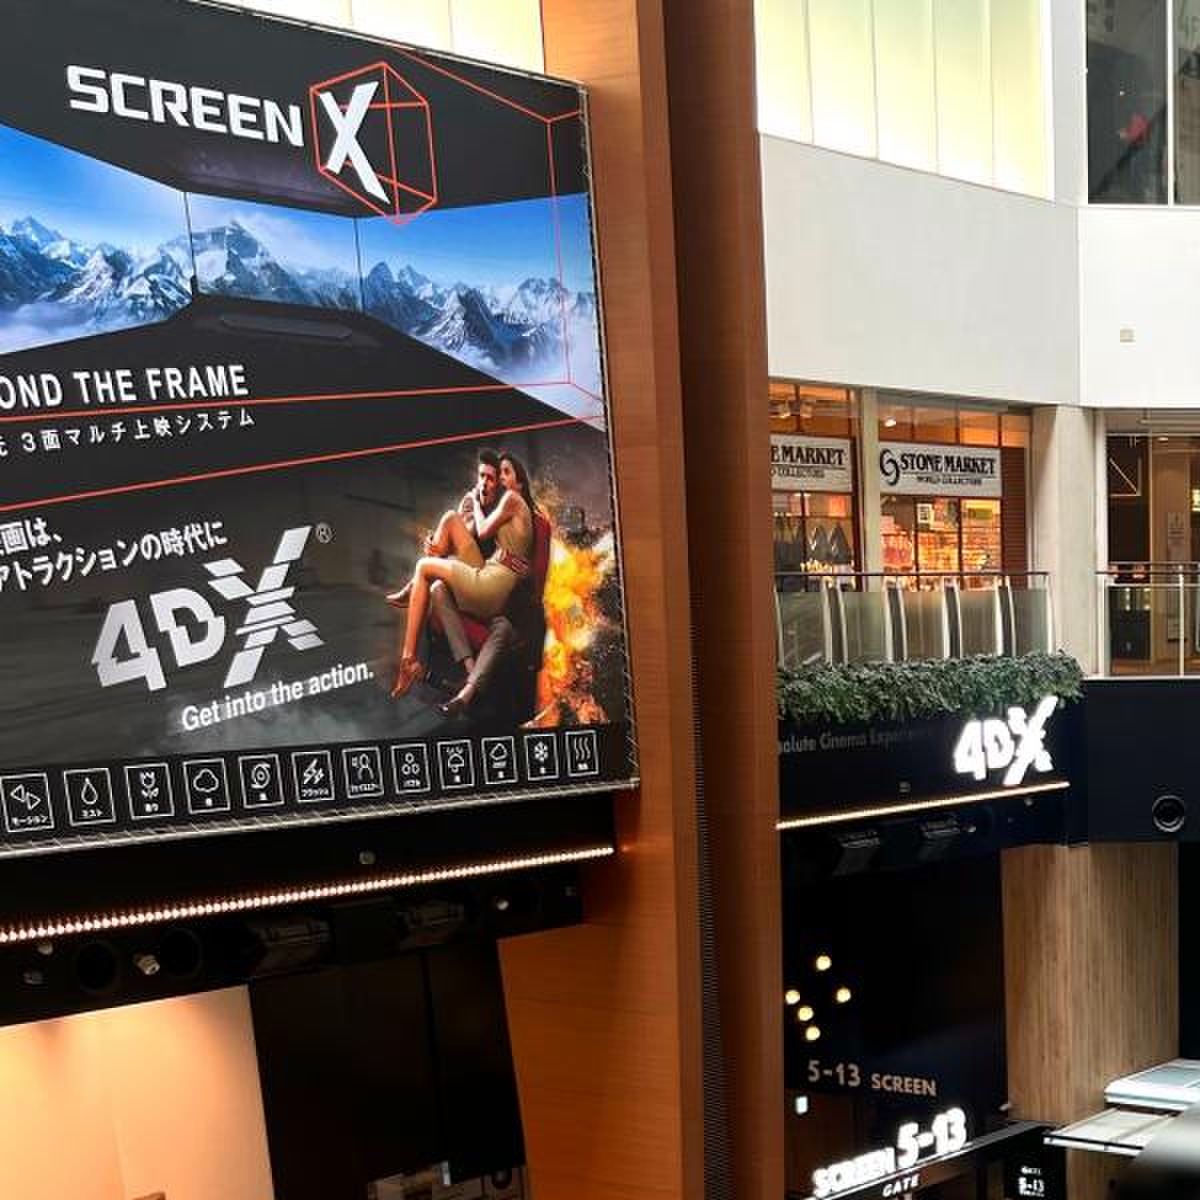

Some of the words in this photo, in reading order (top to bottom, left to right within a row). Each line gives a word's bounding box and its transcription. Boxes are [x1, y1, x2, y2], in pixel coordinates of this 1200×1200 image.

[66, 64, 305, 148] SCREEN
[318, 80, 391, 204] X
[73, 369, 137, 404] THE
[146, 364, 249, 400] FRAME
[782, 446, 845, 466] MARKET
[900, 453, 943, 473] STONE
[944, 455, 996, 475] MARKET
[0, 516, 64, 556] 画は、
[91, 526, 324, 690] 4DX
[181, 700, 221, 731] Get
[224, 690, 266, 719] into
[271, 680, 304, 704] the
[309, 662, 375, 695] action.
[953, 696, 1056, 784] 4DX
[807, 1060, 862, 1087] 5-13
[871, 1073, 938, 1097] SCREEN
[898, 1107, 967, 1170] 5-13
[882, 1173, 921, 1197] GATE
